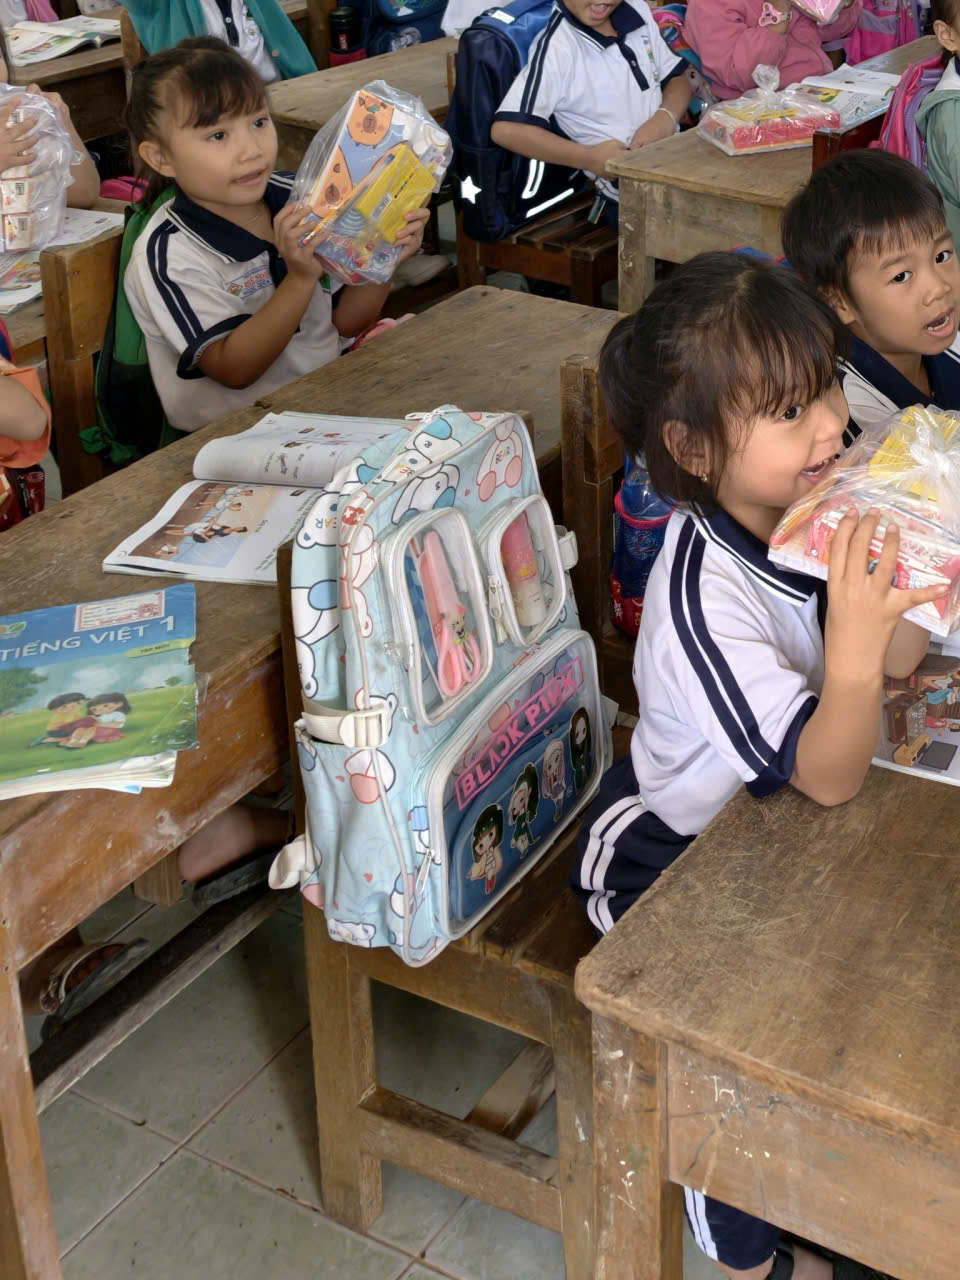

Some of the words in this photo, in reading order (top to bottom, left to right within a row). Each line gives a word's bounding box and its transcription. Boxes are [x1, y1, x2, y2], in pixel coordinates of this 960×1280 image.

[0, 635, 82, 662] TIẾNG
[88, 623, 149, 644] VIỆT
[160, 615, 175, 632] 1
